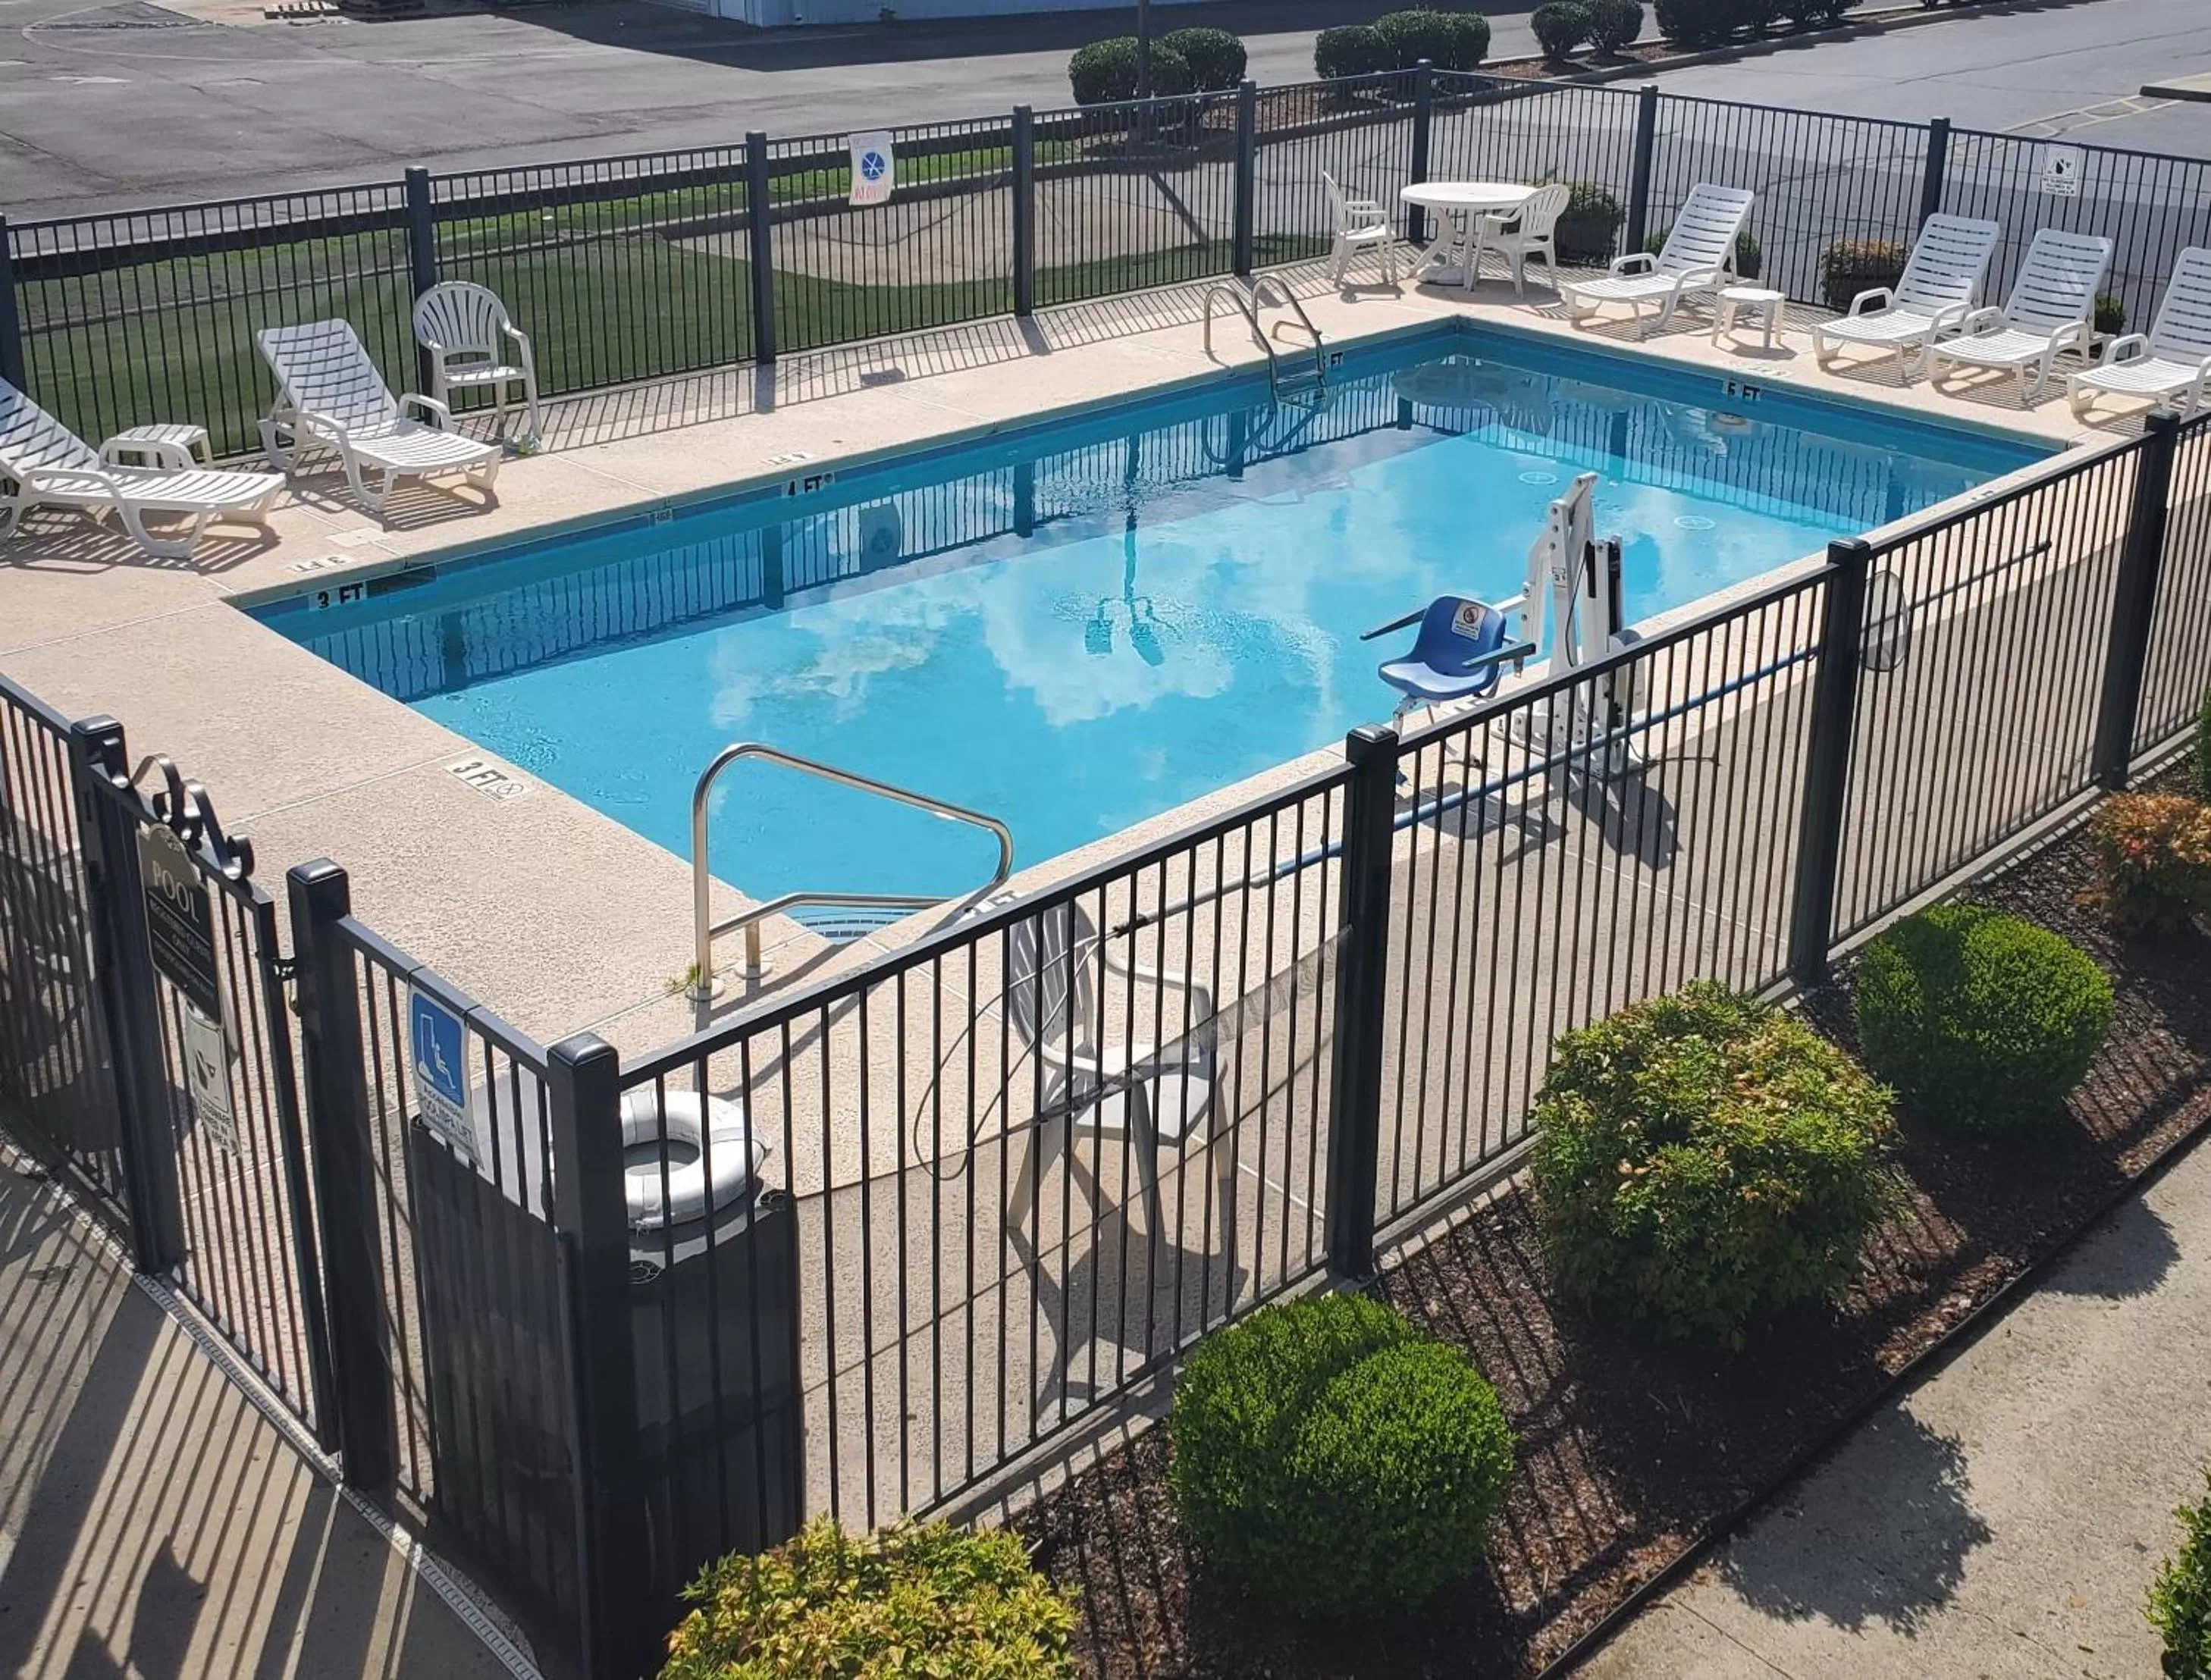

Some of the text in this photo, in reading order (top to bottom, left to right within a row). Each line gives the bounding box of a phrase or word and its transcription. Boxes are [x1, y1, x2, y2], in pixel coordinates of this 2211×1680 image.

[1727, 381, 1761, 402] 5 FT
[788, 475, 823, 496] 4 FT
[317, 583, 364, 610] 3 FT
[453, 761, 509, 787] 3 FT
[152, 859, 200, 924] POOL
